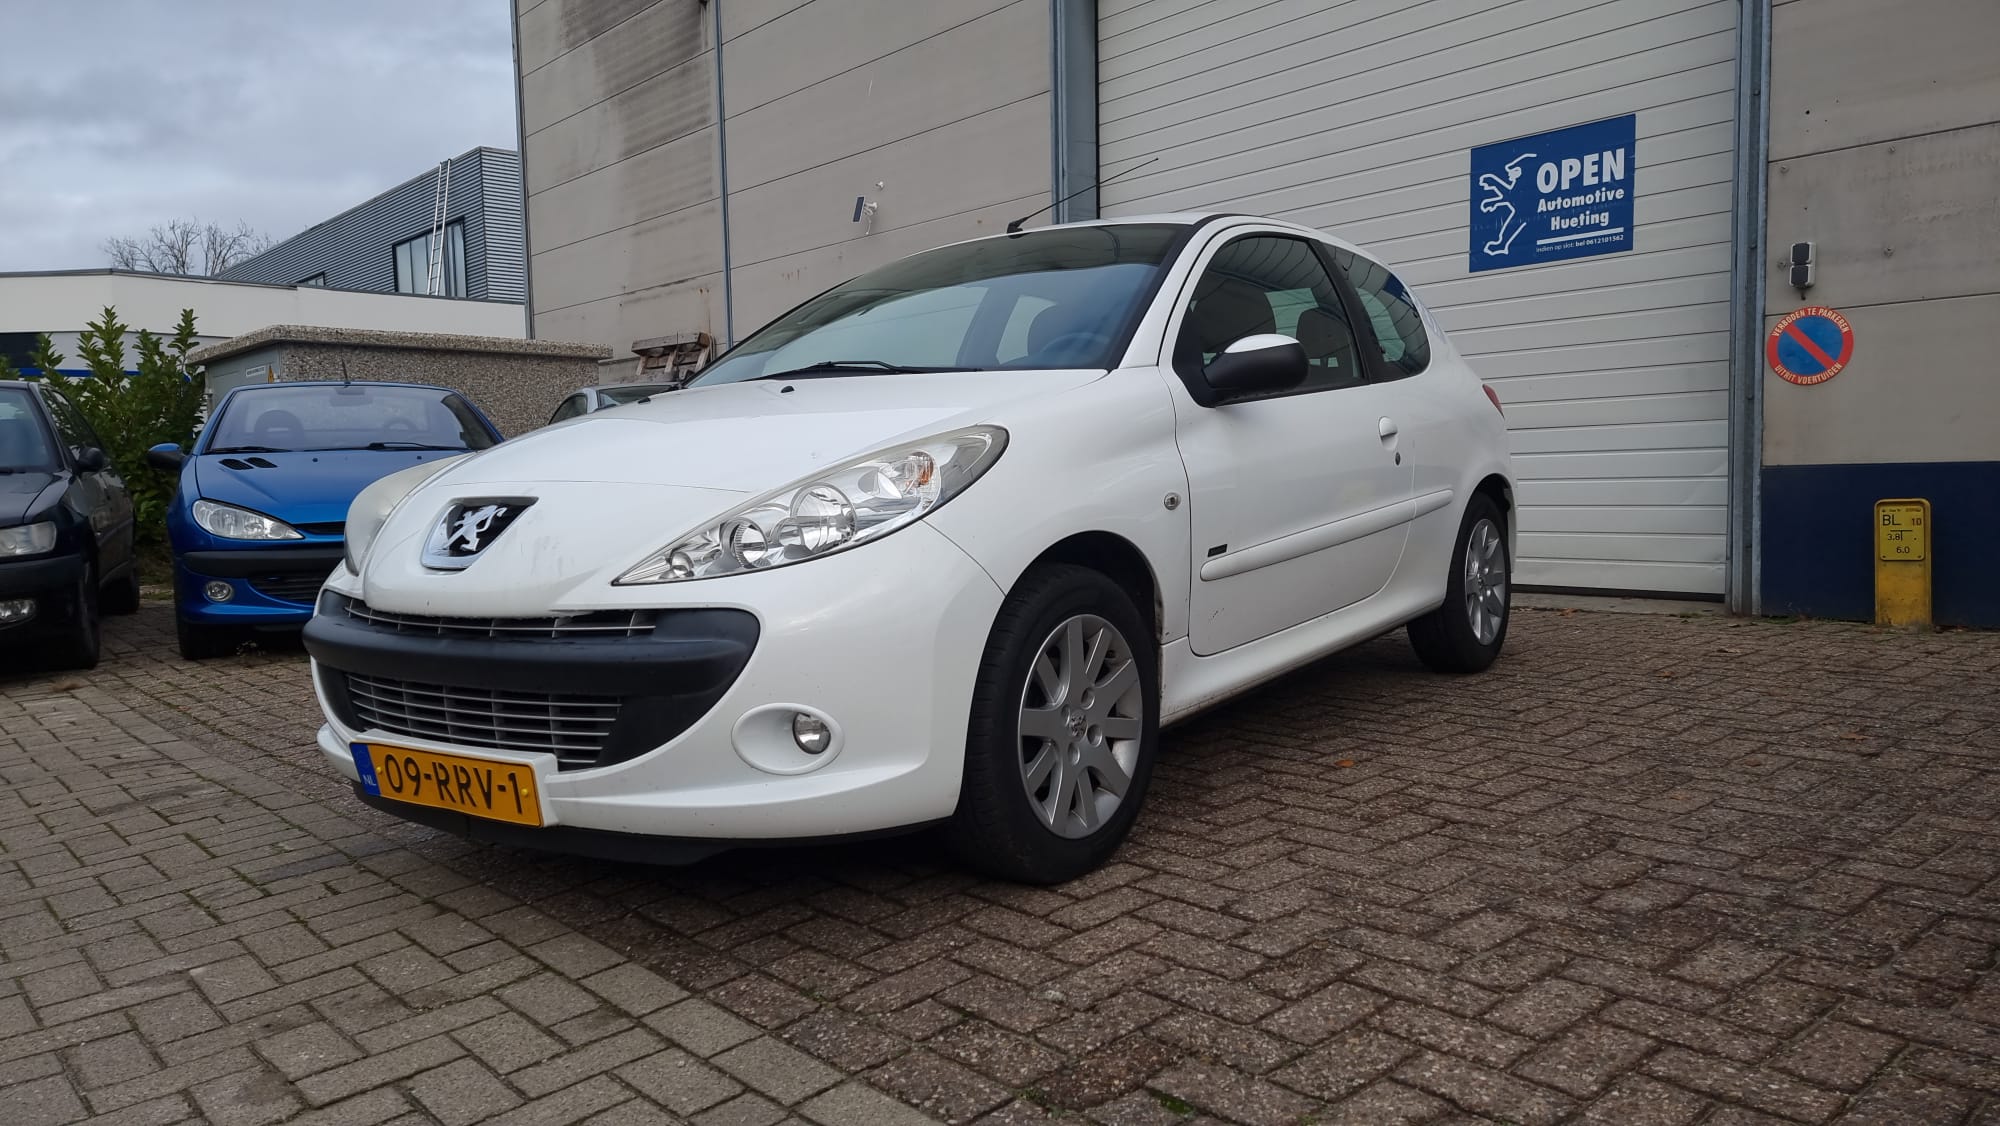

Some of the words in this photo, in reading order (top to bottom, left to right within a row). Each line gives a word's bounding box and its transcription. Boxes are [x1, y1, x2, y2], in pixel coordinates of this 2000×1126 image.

[1537, 148, 1625, 194] OPEN
[1537, 188, 1624, 213] Automotive
[1550, 210, 1610, 231] Hueting
[1575, 239, 1585, 247] bel
[1772, 310, 1805, 337] VERBODEN
[1807, 307, 1817, 316] TE
[1818, 308, 1849, 333] PARKEREN
[1797, 363, 1842, 385] VOERTUIGEN
[1882, 514, 1902, 526] BL
[363, 774, 377, 787] NL
[384, 753, 523, 815] 09-RRV-1
